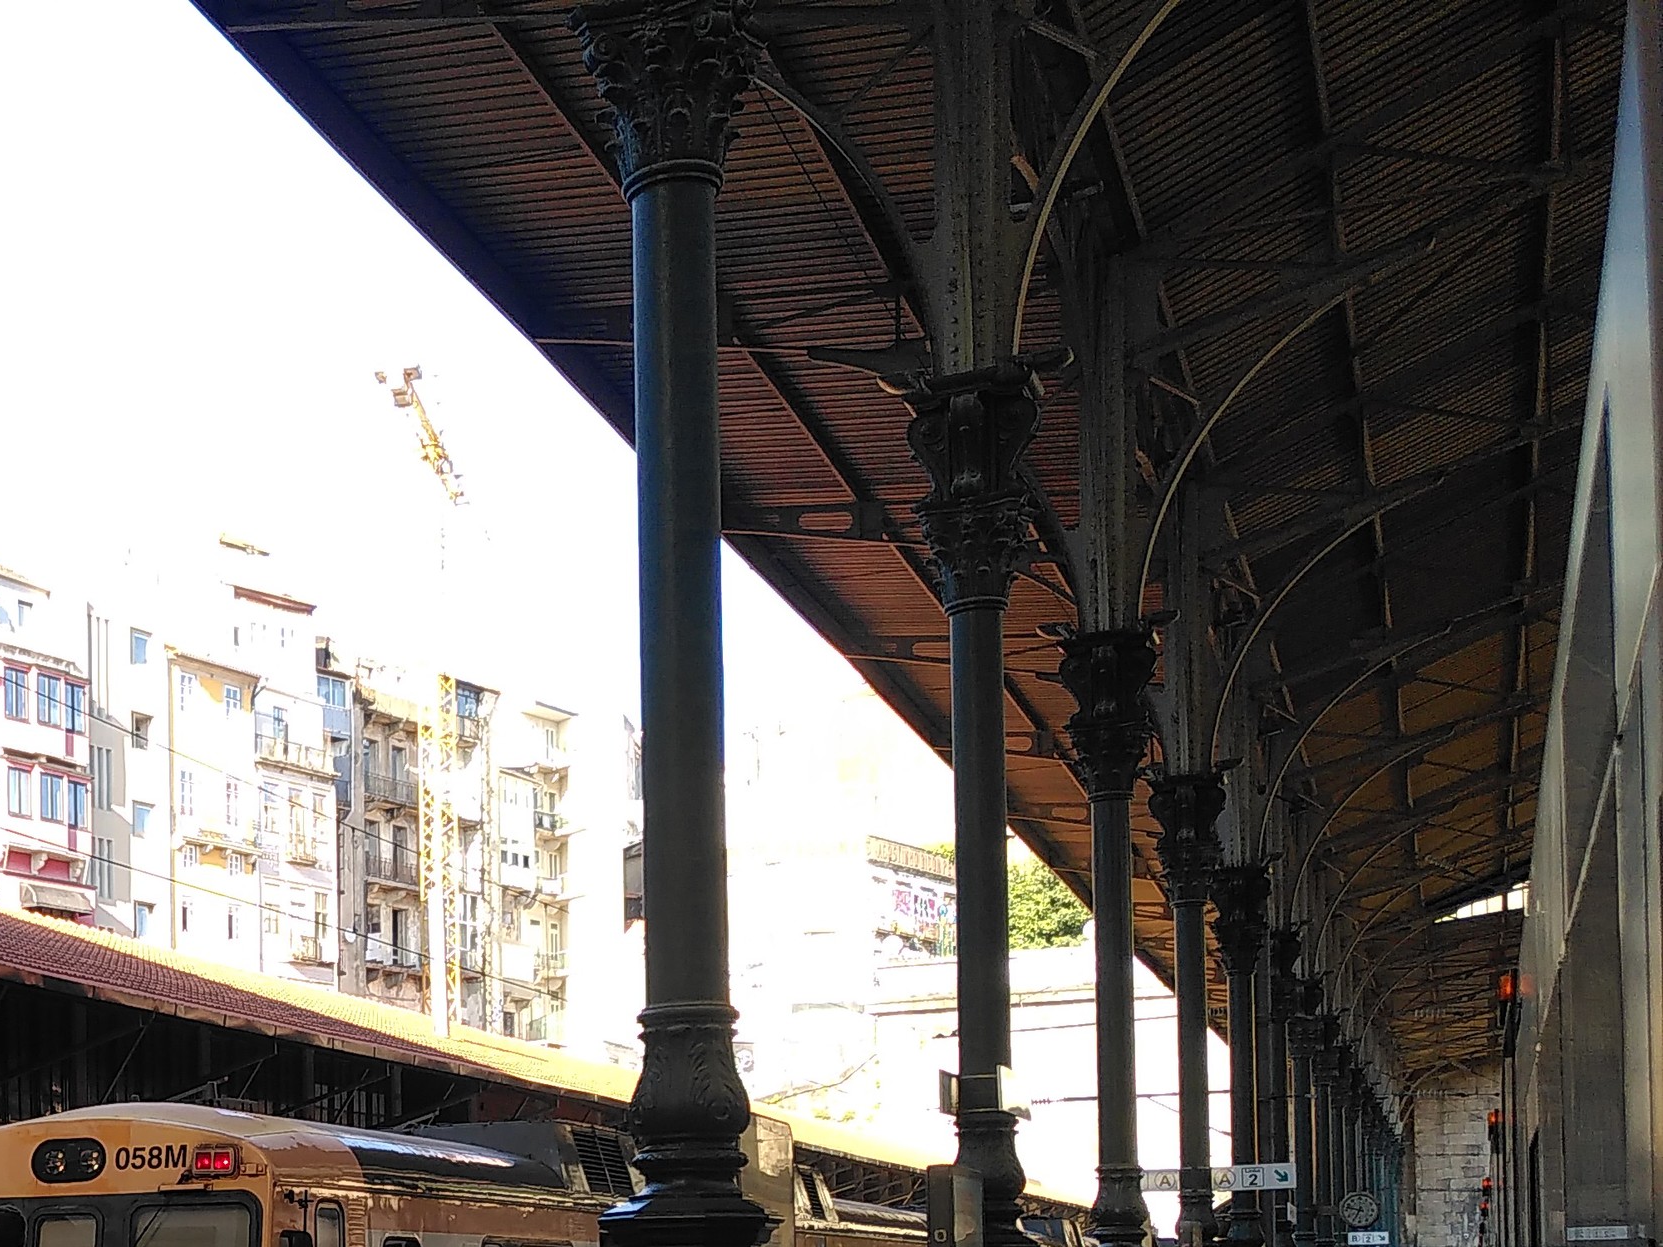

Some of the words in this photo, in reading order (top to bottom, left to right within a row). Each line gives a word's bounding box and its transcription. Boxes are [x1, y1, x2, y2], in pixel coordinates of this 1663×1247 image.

[114, 1145, 188, 1170] 058M
[1159, 1176, 1172, 1187] A
[1218, 1174, 1231, 1185] A
[1248, 1174, 1258, 1186] 2
